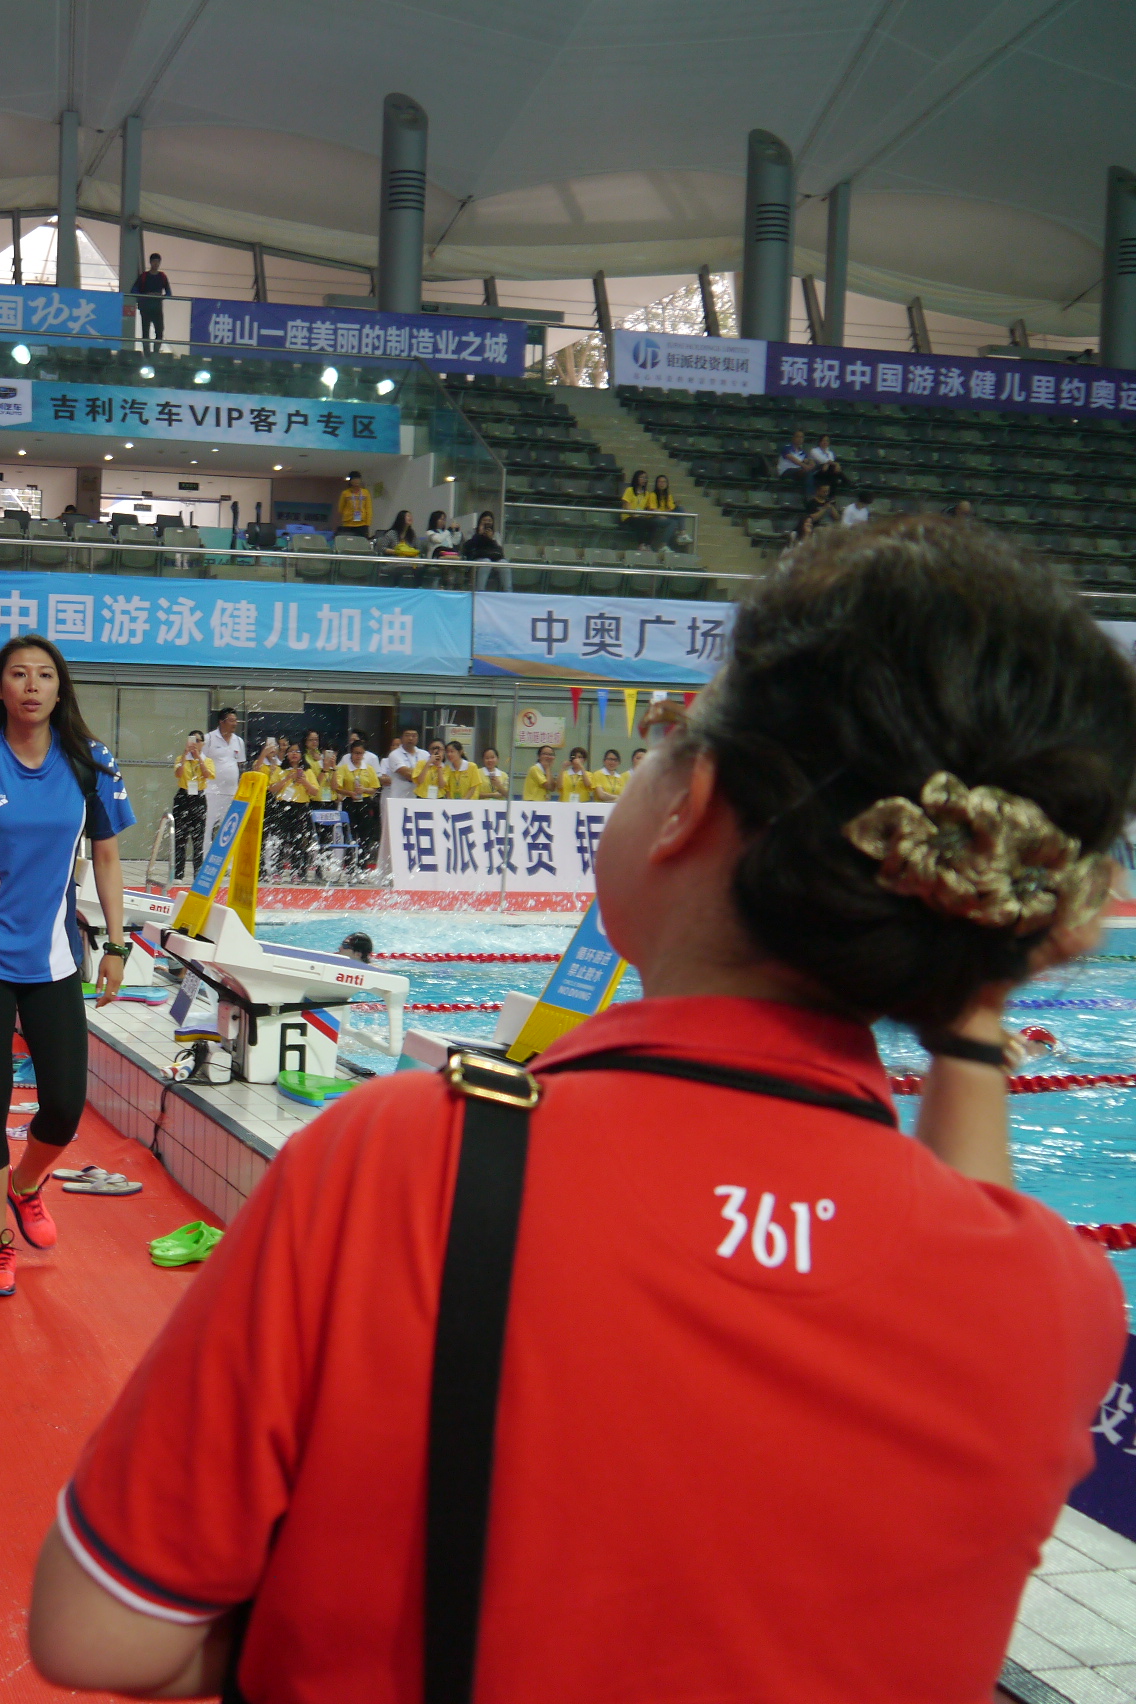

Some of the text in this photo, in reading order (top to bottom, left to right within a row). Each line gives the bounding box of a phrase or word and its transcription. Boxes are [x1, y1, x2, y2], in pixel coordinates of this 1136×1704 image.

[208, 313, 509, 364] 佛山一座美丽的制造业之城
[666, 352, 750, 373] 钜派投资集团
[50, 394, 378, 440] 吉利汽车VIP客户专区
[530, 609, 728, 661] 中奥广场
[401, 807, 558, 877] 钜派投资
[149, 902, 171, 915] anti
[335, 971, 365, 987] anti
[279, 1022, 308, 1074] 6
